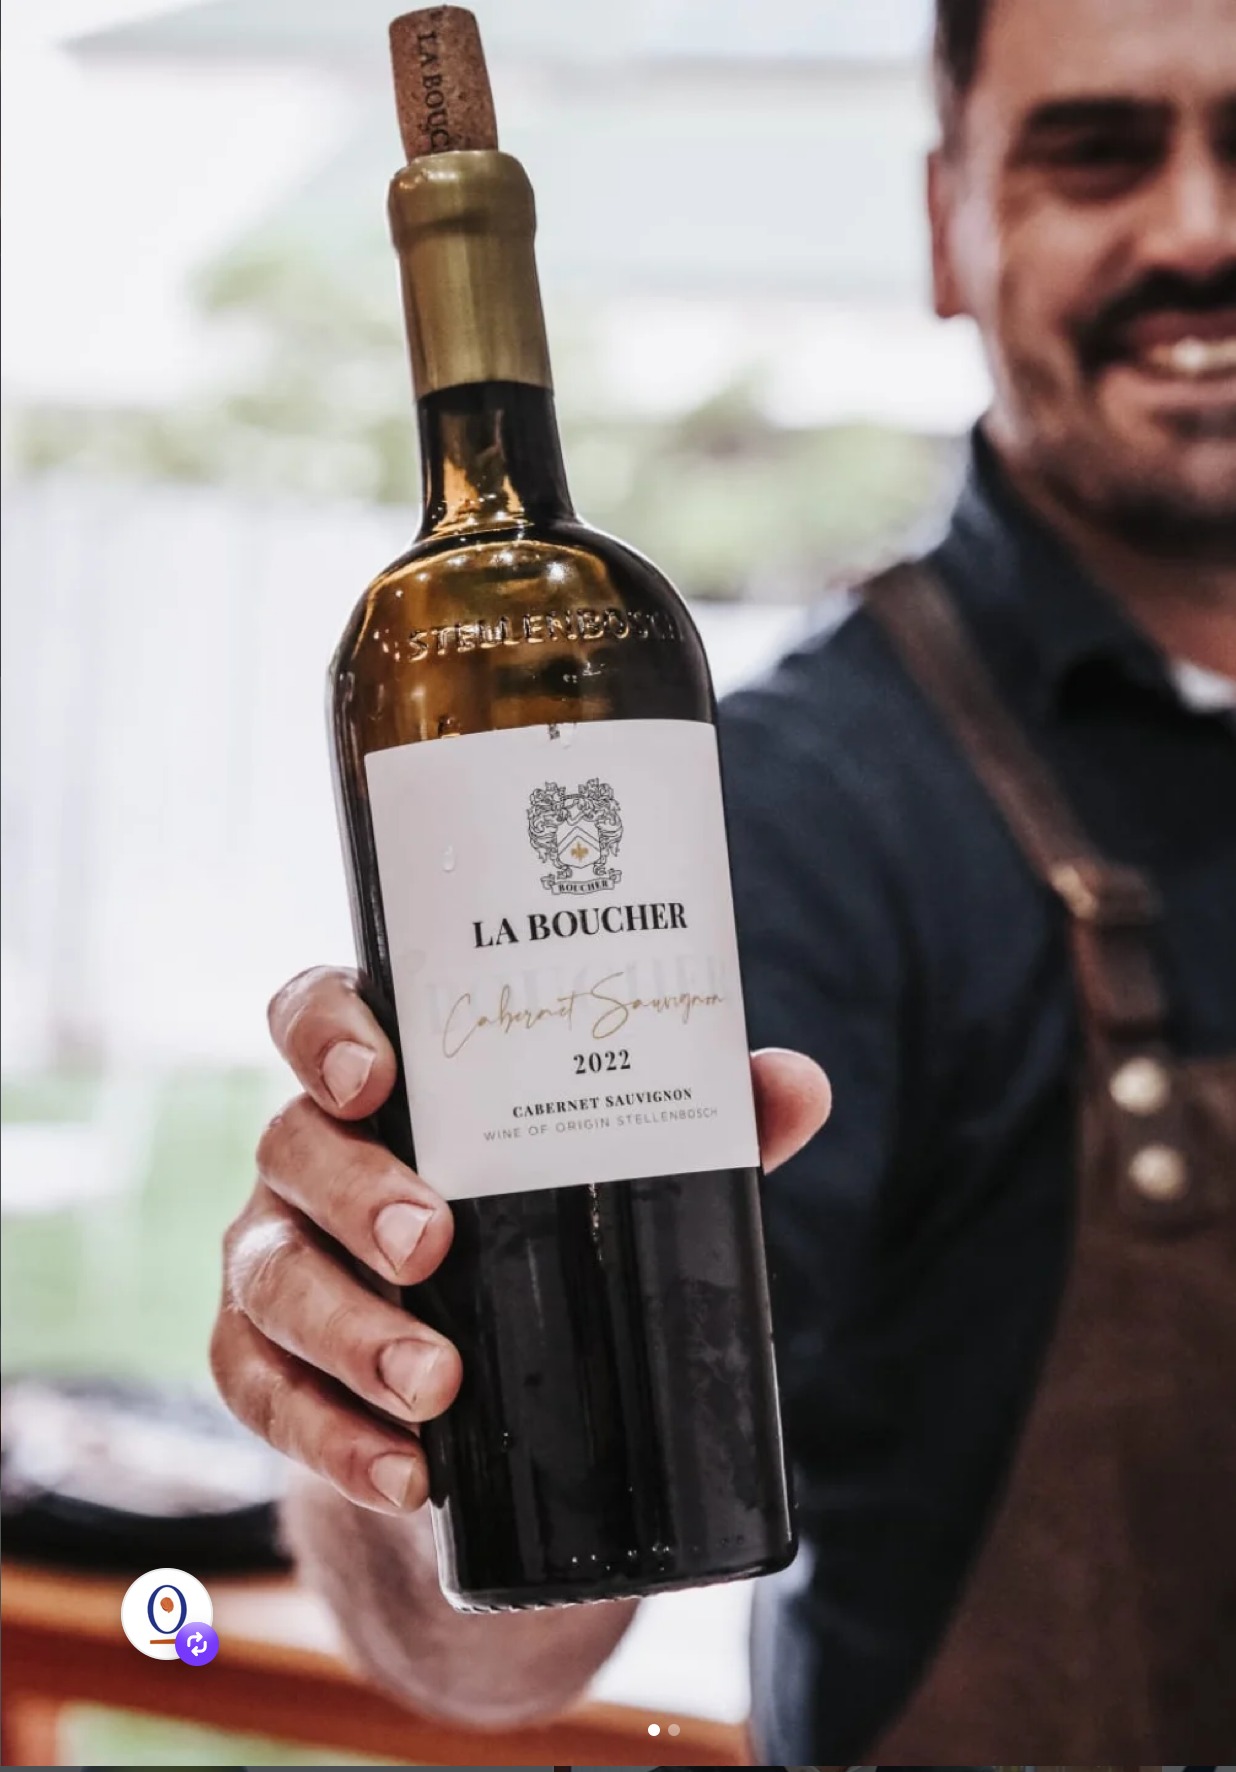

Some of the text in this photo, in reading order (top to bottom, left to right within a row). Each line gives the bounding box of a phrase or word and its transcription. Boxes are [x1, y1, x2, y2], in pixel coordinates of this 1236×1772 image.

[416, 30, 440, 68] LA
[558, 879, 608, 892] BOUCHER
[472, 902, 688, 949] LA BOUCHER
[442, 971, 725, 1059] Cabernet Sauvignon
[573, 1049, 631, 1075] 2022
[512, 1087, 692, 1119] CABERNET SAUVIGNON
[482, 1106, 719, 1142] WINE OF ORIGIN STELLENBOSCH
